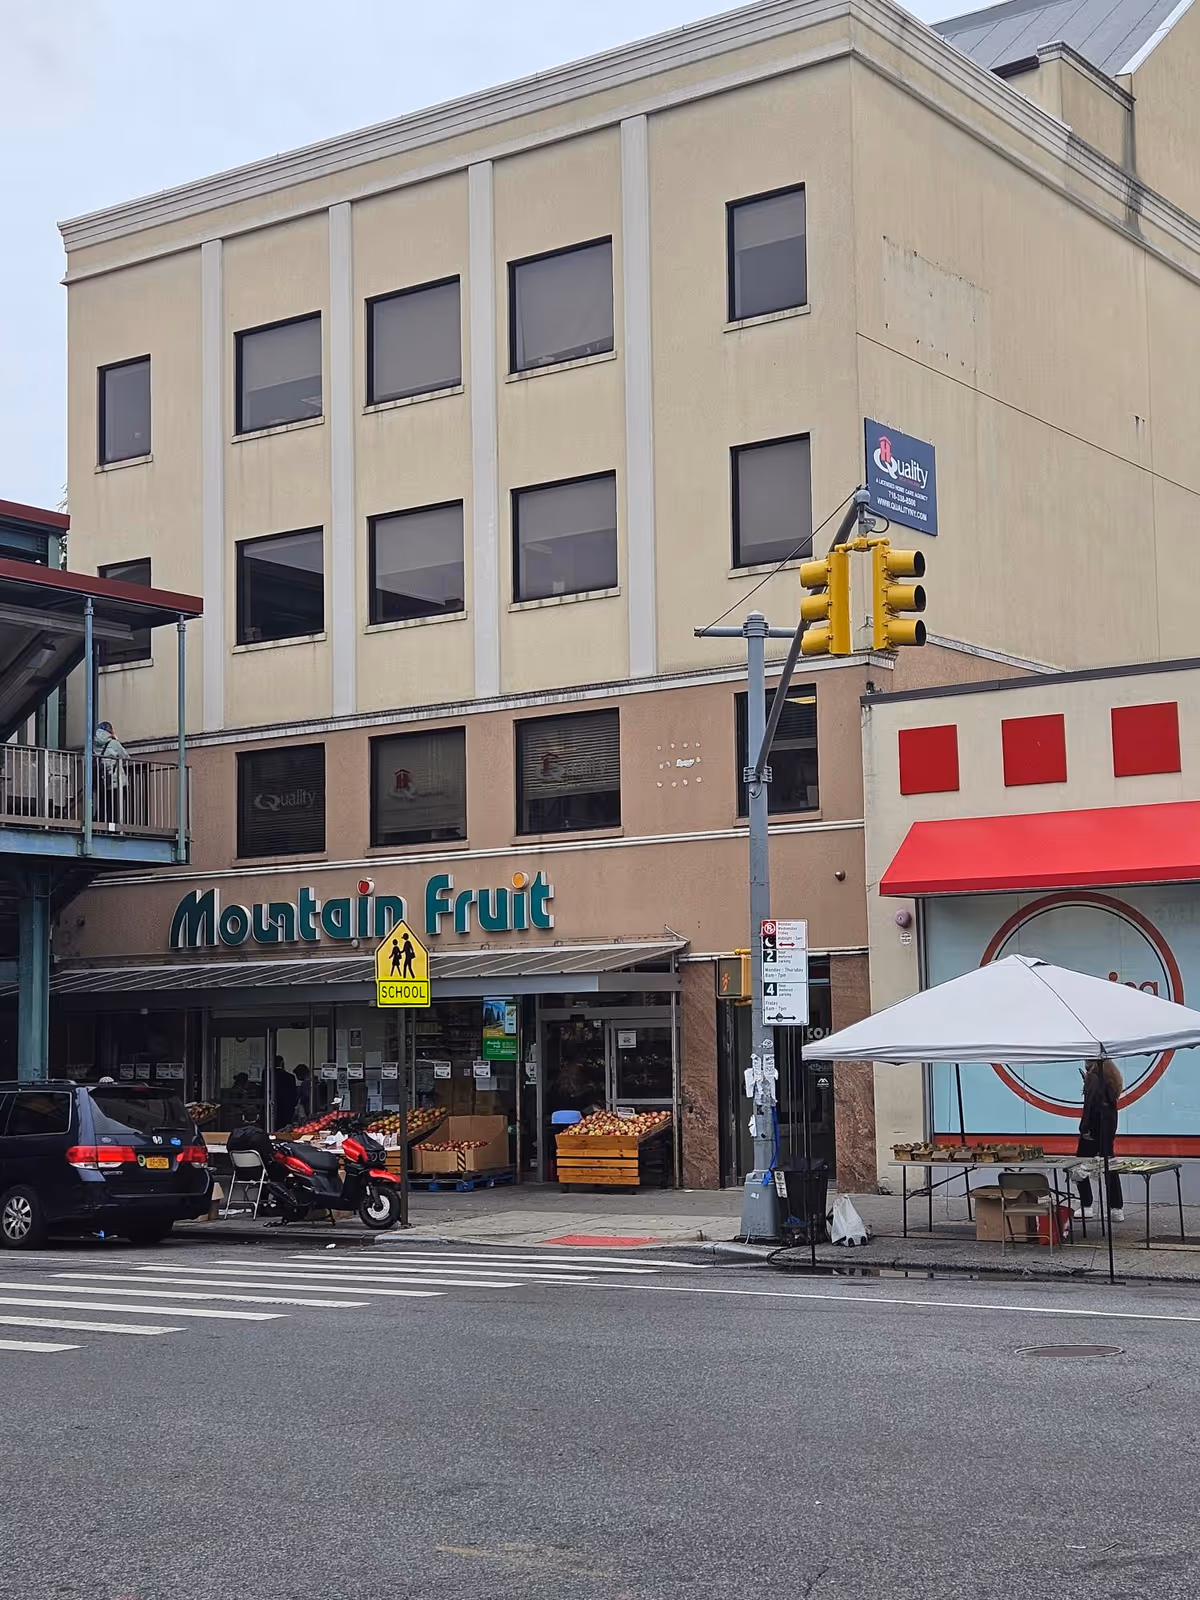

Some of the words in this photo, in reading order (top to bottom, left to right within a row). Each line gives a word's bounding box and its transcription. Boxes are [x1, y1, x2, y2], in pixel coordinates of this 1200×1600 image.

[873, 448, 928, 489] Quality
[254, 789, 315, 811] Quality
[169, 878, 408, 948] Mountain
[766, 950, 774, 962] 2
[381, 985, 426, 998] SCHOOL
[766, 983, 775, 996] 4
[806, 1027, 836, 1039] COJ
